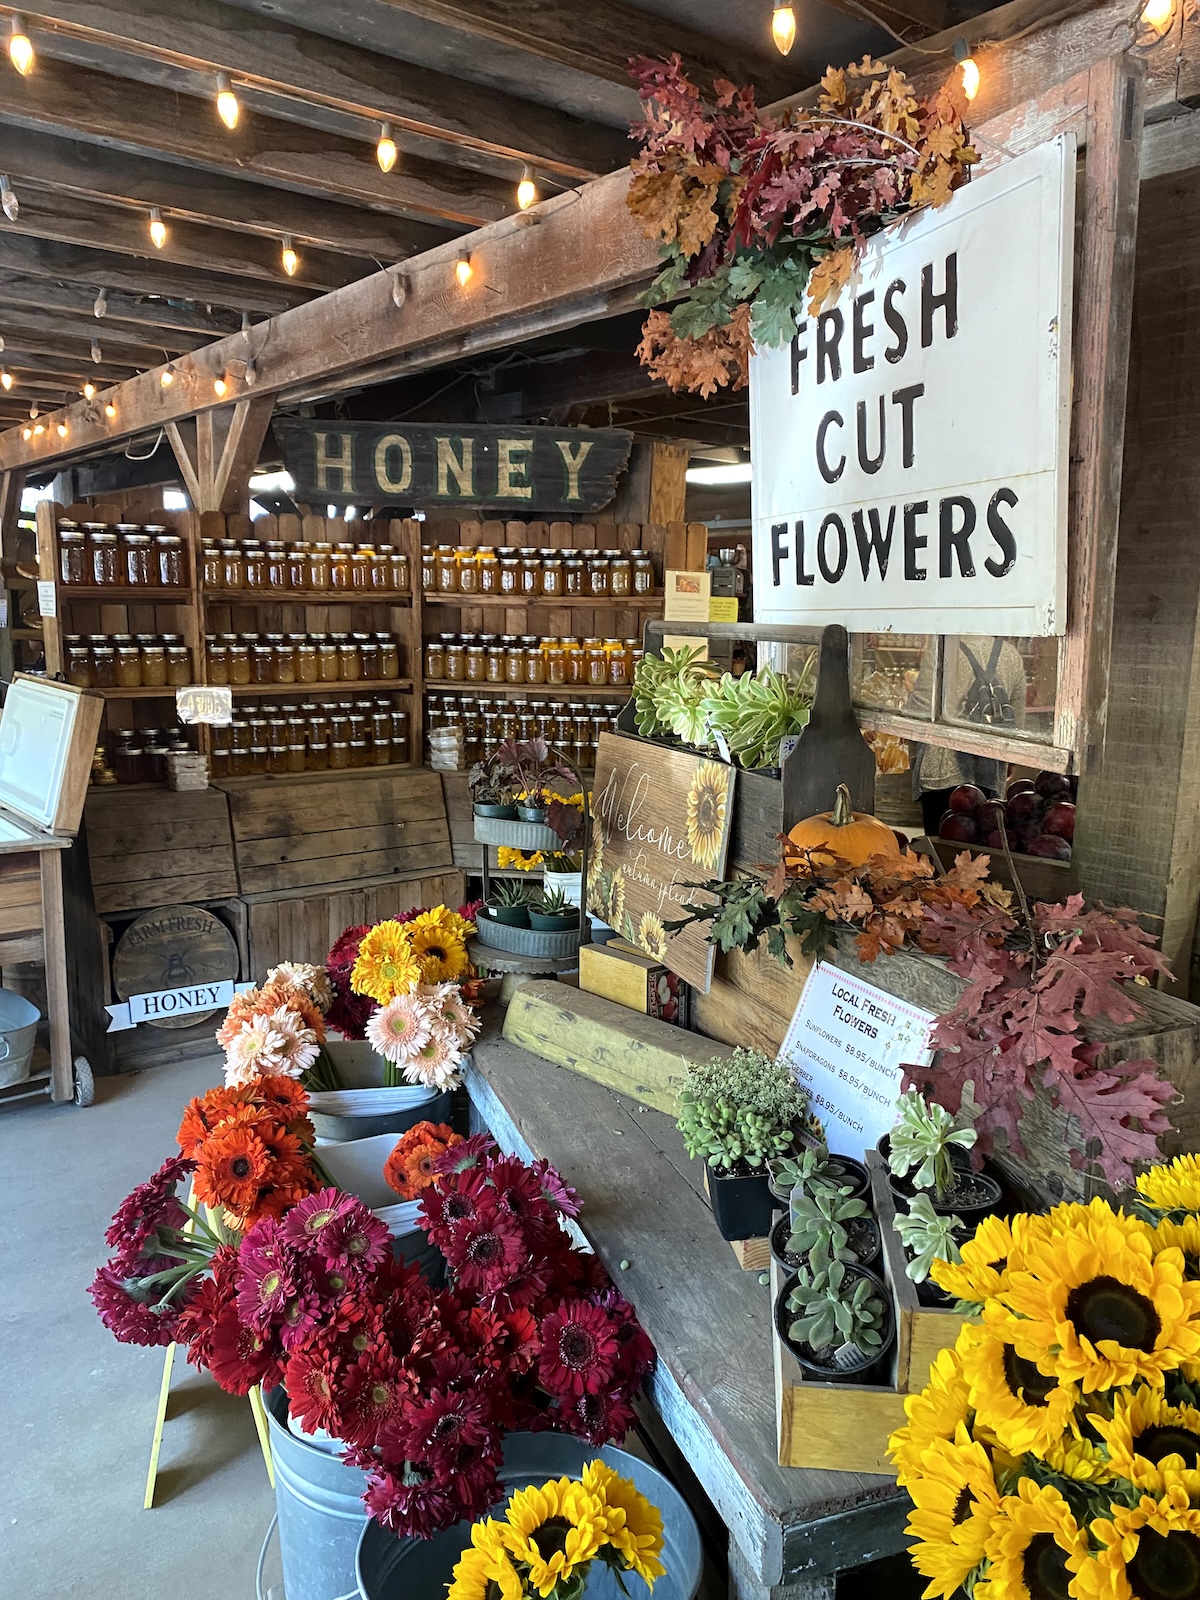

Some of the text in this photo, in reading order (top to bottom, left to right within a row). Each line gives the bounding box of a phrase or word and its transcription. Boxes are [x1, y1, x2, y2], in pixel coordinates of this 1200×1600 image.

[790, 251, 958, 396] FRESH
[816, 383, 925, 484] CUT
[313, 432, 594, 500] HONEY
[771, 488, 1019, 586] FLOWERS
[593, 763, 693, 860] Welcome
[127, 921, 166, 947] FARM
[168, 916, 215, 934] FRESH
[143, 986, 221, 1015] HONEY
[832, 983, 896, 1027] LOCAL FRESH
[805, 1019, 842, 1048] SUNFLOWERS
[833, 1005, 879, 1039] FLOWERS
[791, 1064, 814, 1084] GERBER
[795, 1041, 836, 1073] SNAPDRAGONS
